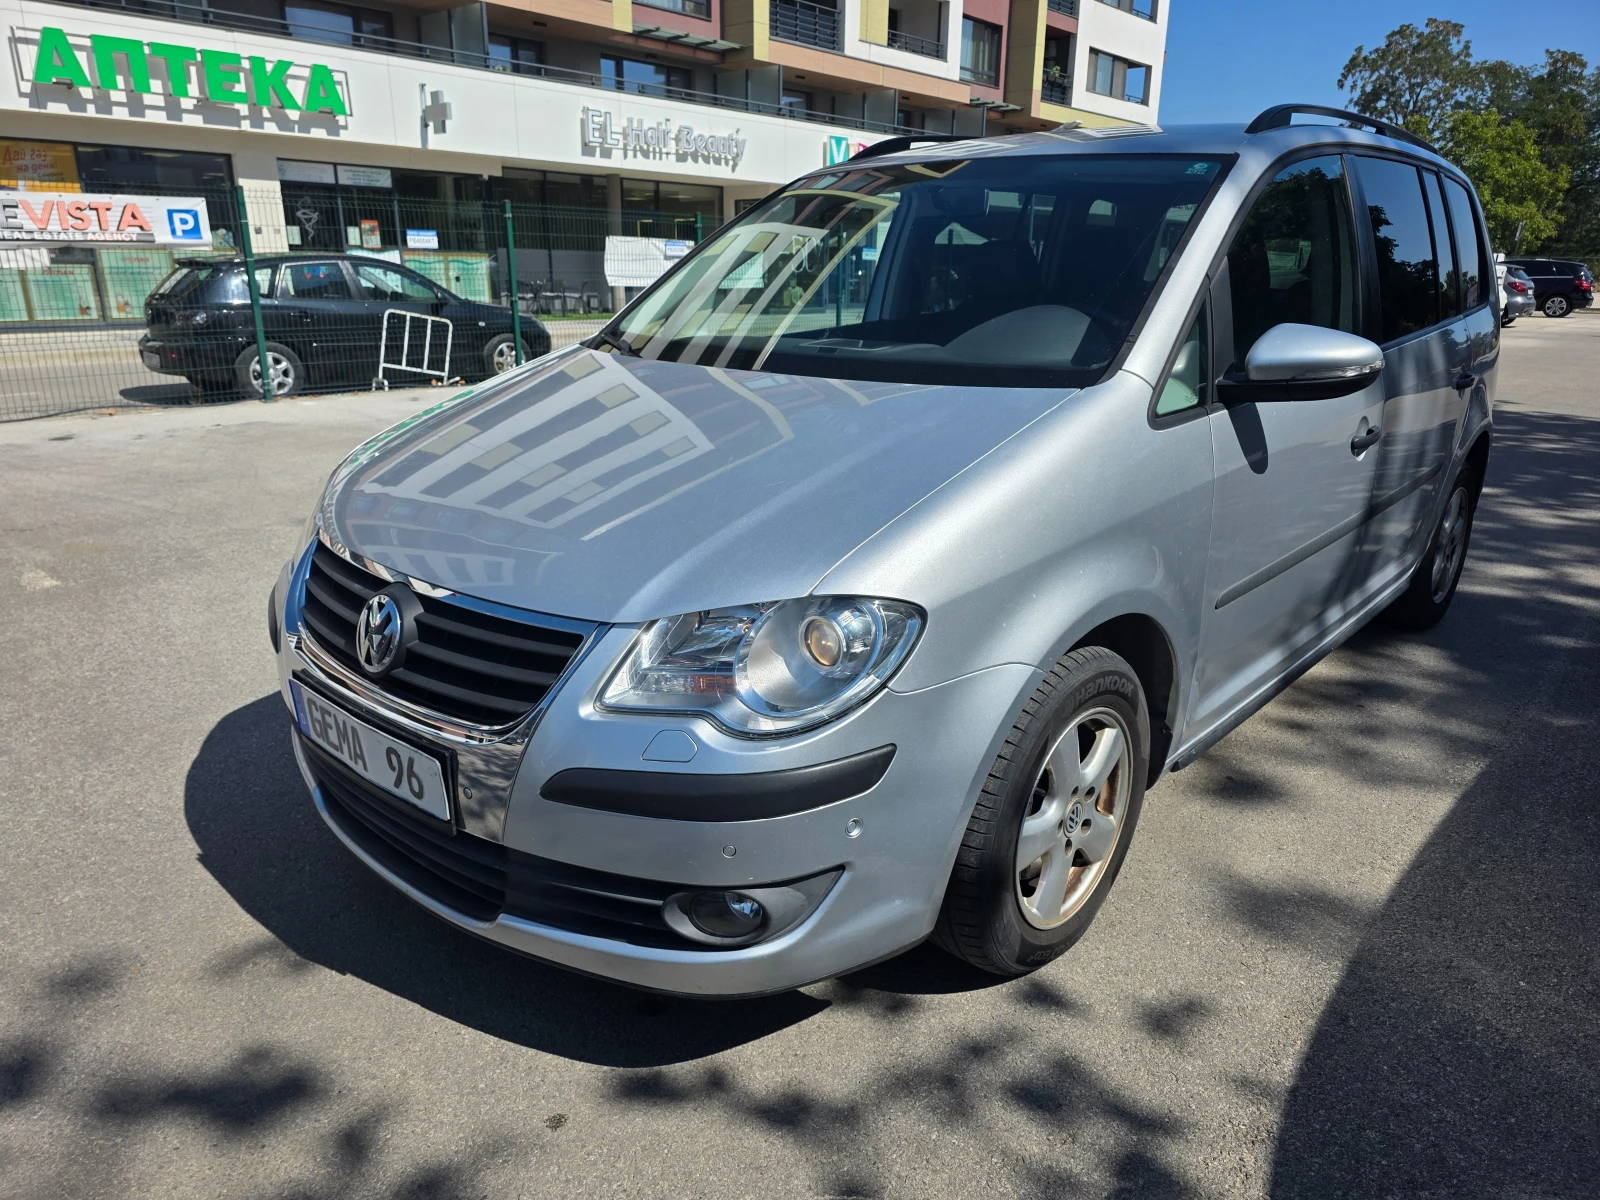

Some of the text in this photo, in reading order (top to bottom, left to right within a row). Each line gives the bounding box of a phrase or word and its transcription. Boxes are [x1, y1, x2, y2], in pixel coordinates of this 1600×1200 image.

[33, 26, 347, 116] АПТЕКА
[587, 108, 747, 162] EL Hair Beauty
[33, 231, 84, 241] ESTATE
[87, 232, 138, 241] AGENCY
[172, 212, 195, 236] P
[306, 697, 424, 801] GEMA 96
